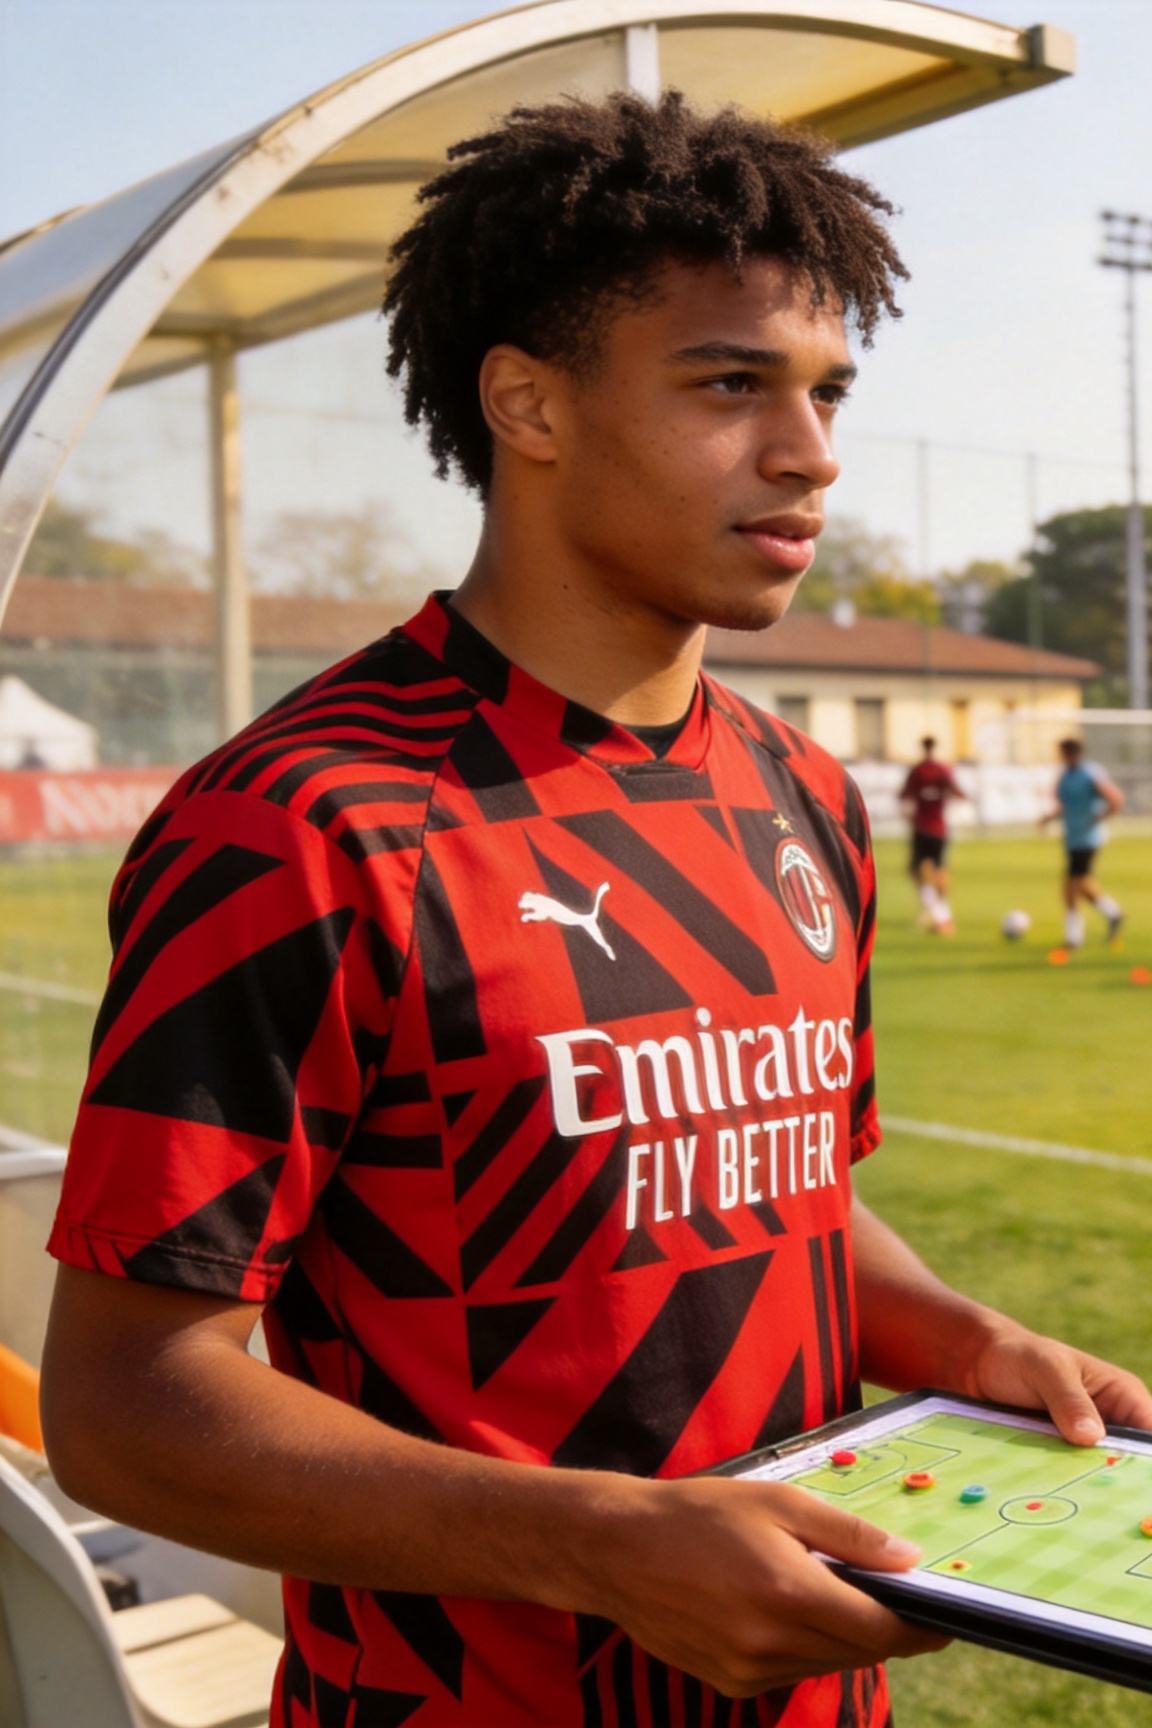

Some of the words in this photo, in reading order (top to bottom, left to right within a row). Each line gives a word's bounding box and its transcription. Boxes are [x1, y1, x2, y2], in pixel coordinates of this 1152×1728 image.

[535, 1005, 853, 1137] Emirates
[625, 1134, 698, 1231] FLY
[716, 1110, 837, 1211] BETTER
